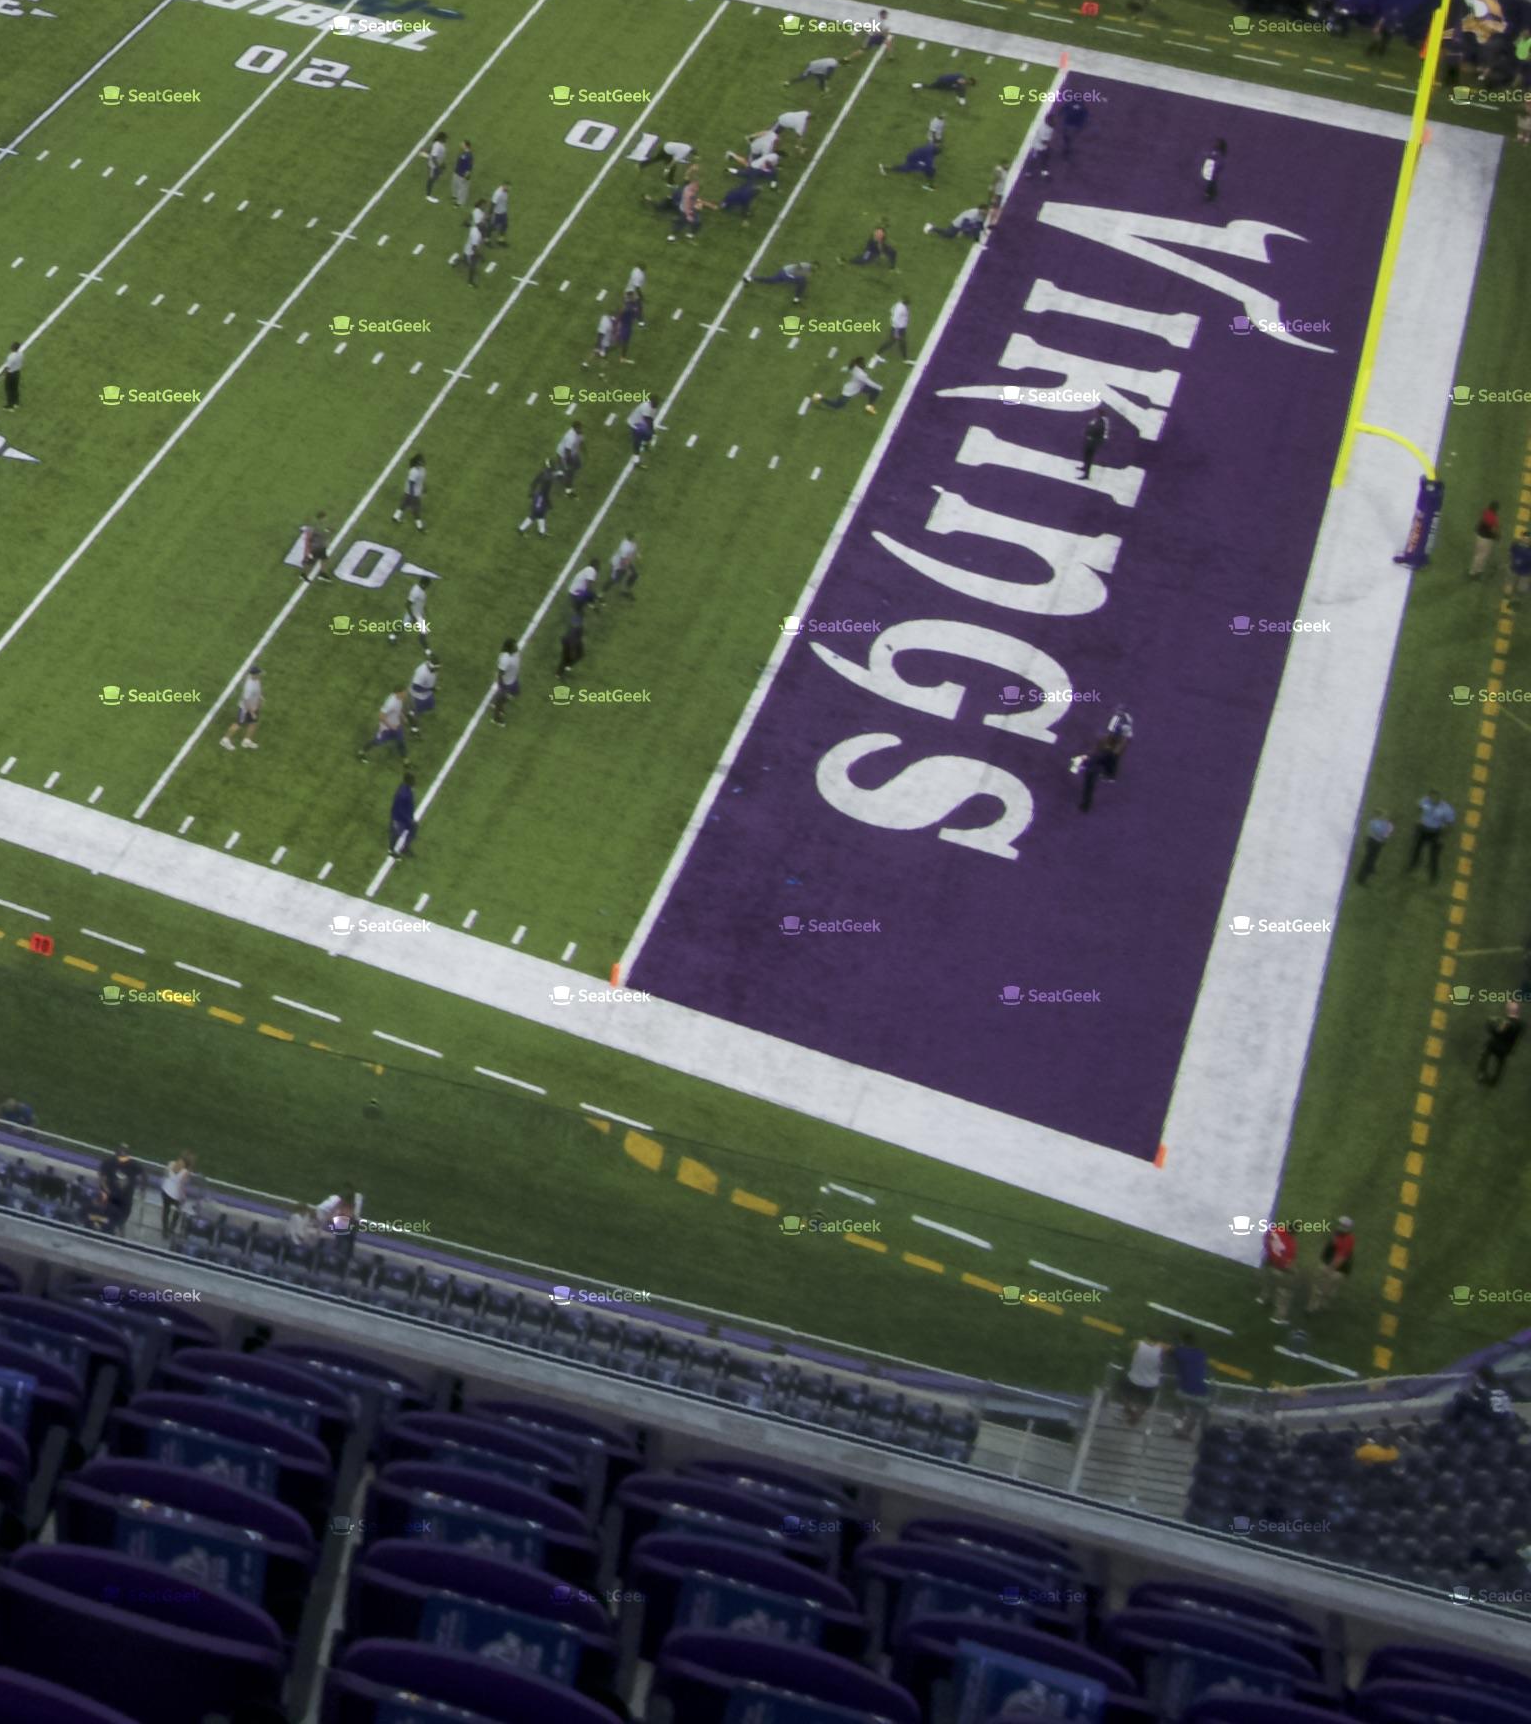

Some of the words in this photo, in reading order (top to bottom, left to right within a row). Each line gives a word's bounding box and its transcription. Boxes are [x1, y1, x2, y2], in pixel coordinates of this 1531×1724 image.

[234, 44, 351, 89] 20
[564, 118, 659, 162] 10
[810, 201, 1337, 860] VIKINGS
